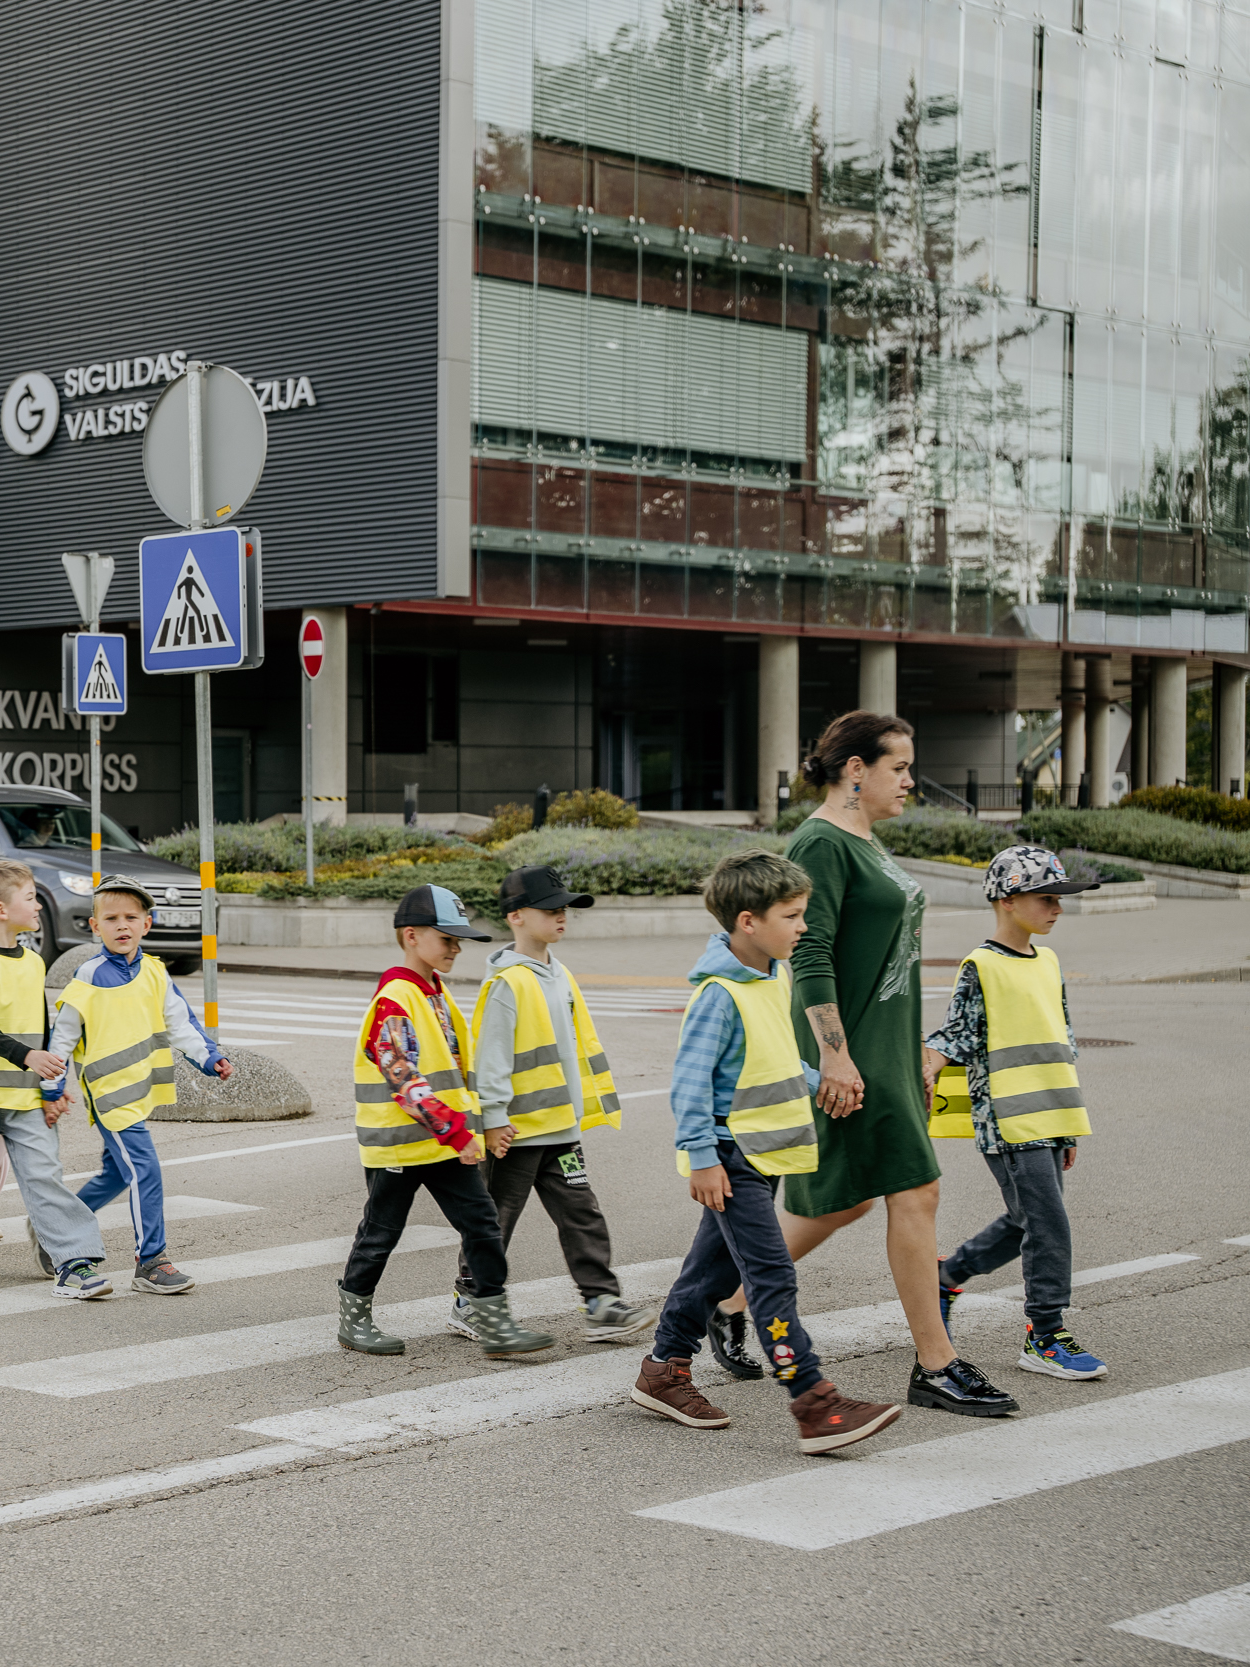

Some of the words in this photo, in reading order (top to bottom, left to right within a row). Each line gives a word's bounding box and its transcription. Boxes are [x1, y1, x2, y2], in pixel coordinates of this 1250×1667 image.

[64, 350, 187, 398] SIGULDAS
[64, 402, 150, 441] VALSTS
[246, 376, 317, 412] ZIJA
